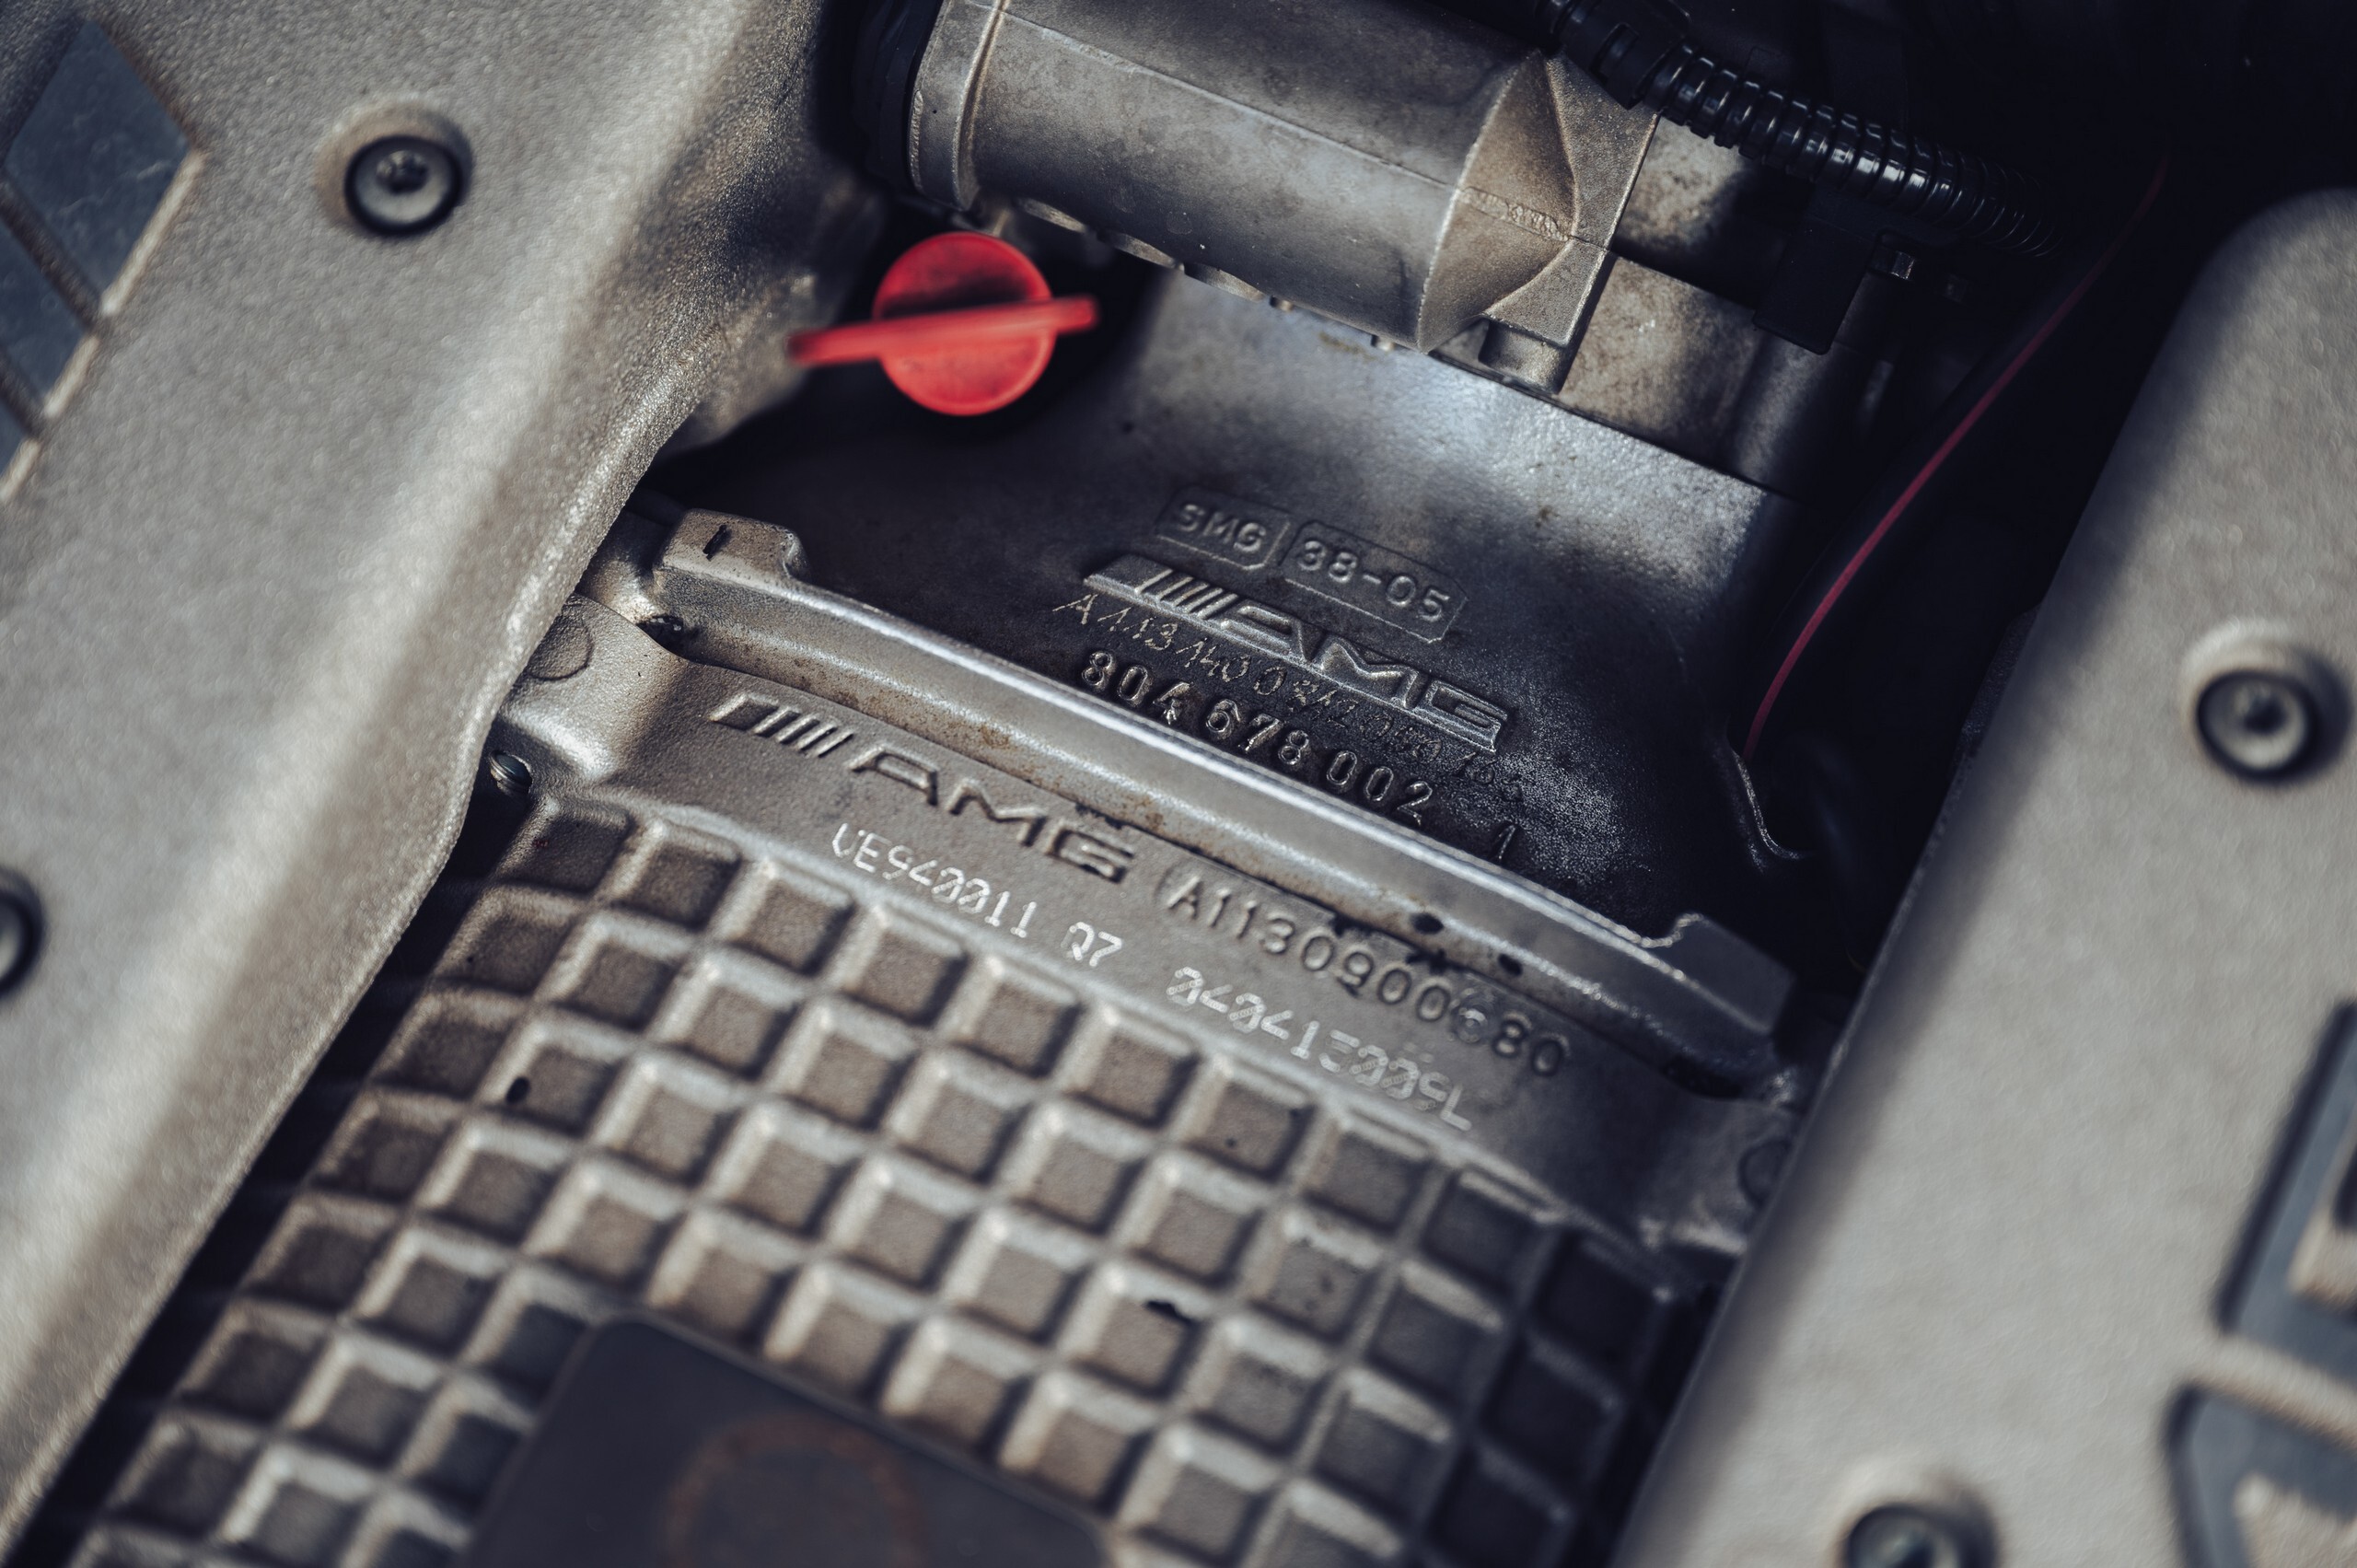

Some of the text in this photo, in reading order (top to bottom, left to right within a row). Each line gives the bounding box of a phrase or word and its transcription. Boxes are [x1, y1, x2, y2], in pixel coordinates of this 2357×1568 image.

[1176, 503, 1268, 554] SMG
[1295, 539, 1453, 623] 38-05
[1220, 602, 1508, 751] AMG
[845, 743, 1134, 884] AMG
